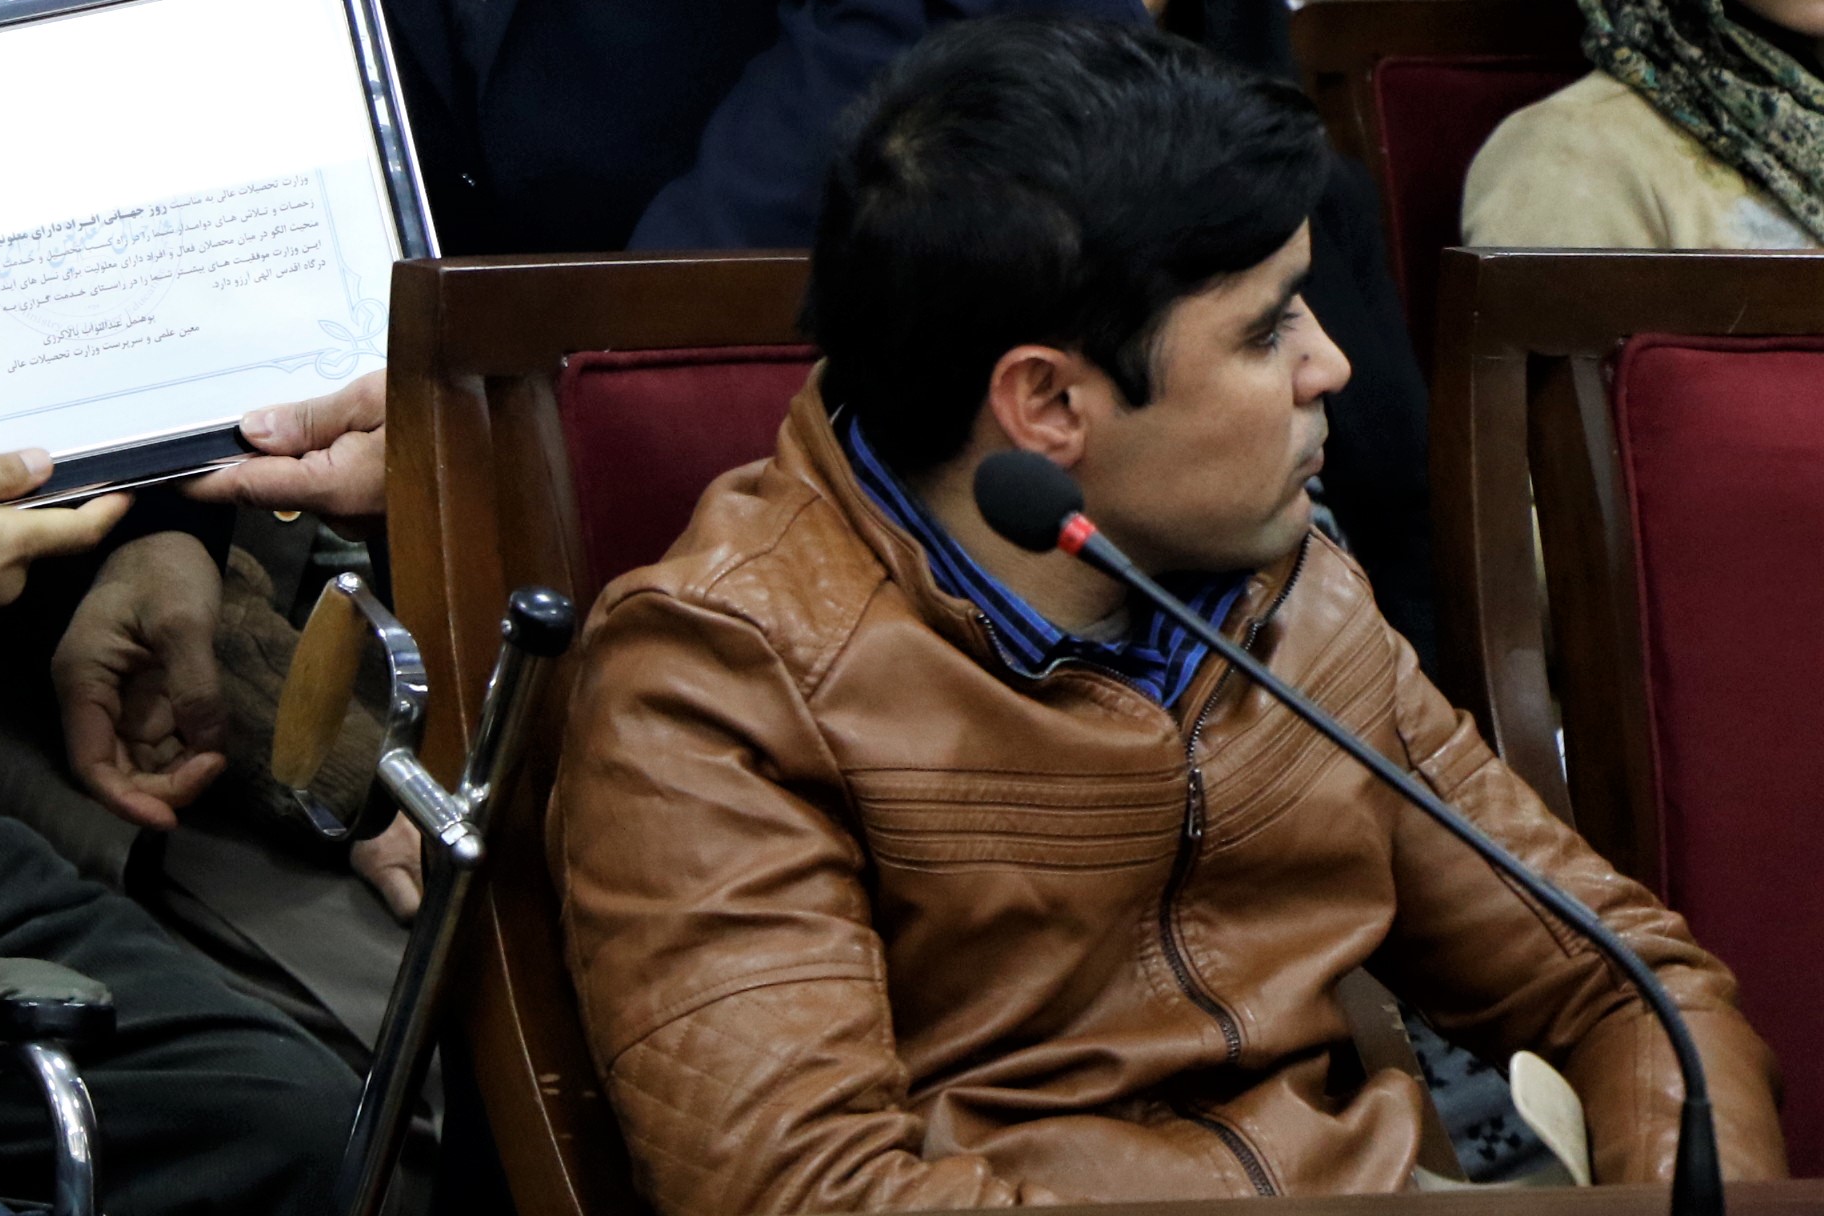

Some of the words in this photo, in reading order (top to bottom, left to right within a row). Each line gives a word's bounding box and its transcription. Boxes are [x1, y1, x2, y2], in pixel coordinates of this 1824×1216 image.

[282, 175, 309, 188] وزارت
[103, 207, 145, 226] جهانی
[148, 205, 168, 218] روز
[65, 213, 101, 232] افراد
[31, 222, 63, 241] دارای
[272, 245, 300, 258] وزارت
[120, 254, 144, 270] دارای
[207, 260, 231, 273] های
[19, 277, 38, 291] های
[73, 344, 101, 358] وزارت
